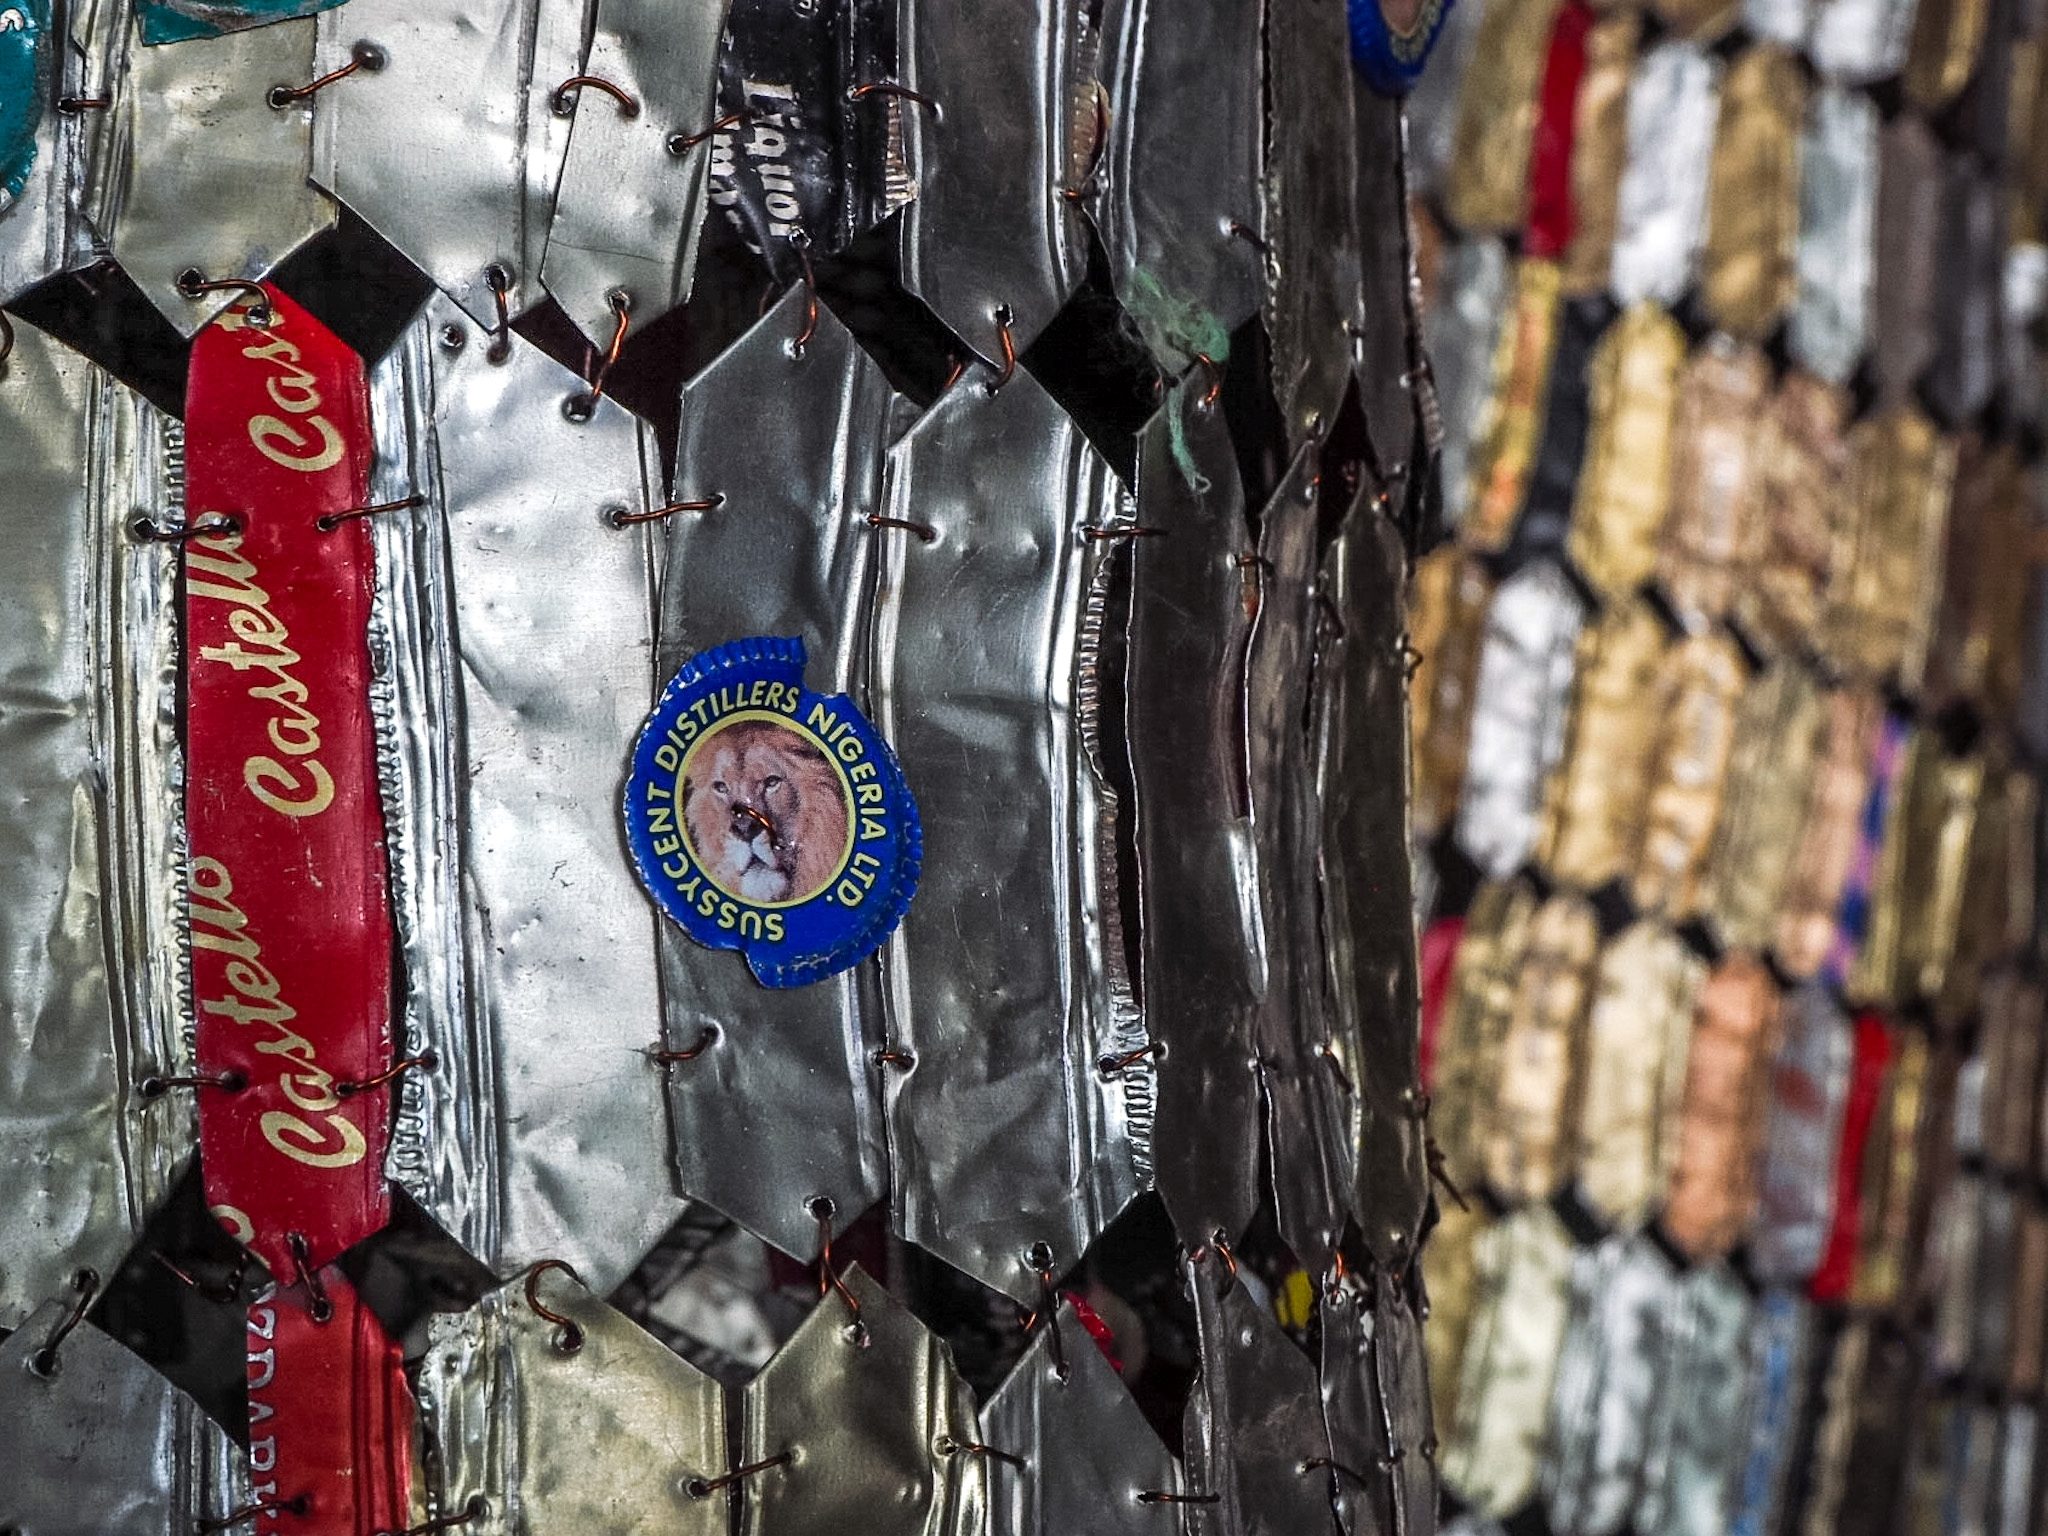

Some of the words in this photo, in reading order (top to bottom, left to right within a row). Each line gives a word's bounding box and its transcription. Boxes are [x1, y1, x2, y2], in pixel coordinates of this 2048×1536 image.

[654, 680, 800, 773] DISTILLERS
[806, 702, 887, 841] NIGERIA
[646, 781, 785, 942] SUSSYCENT
[826, 852, 881, 908] LTD.
[186, 855, 368, 1168] Castello
